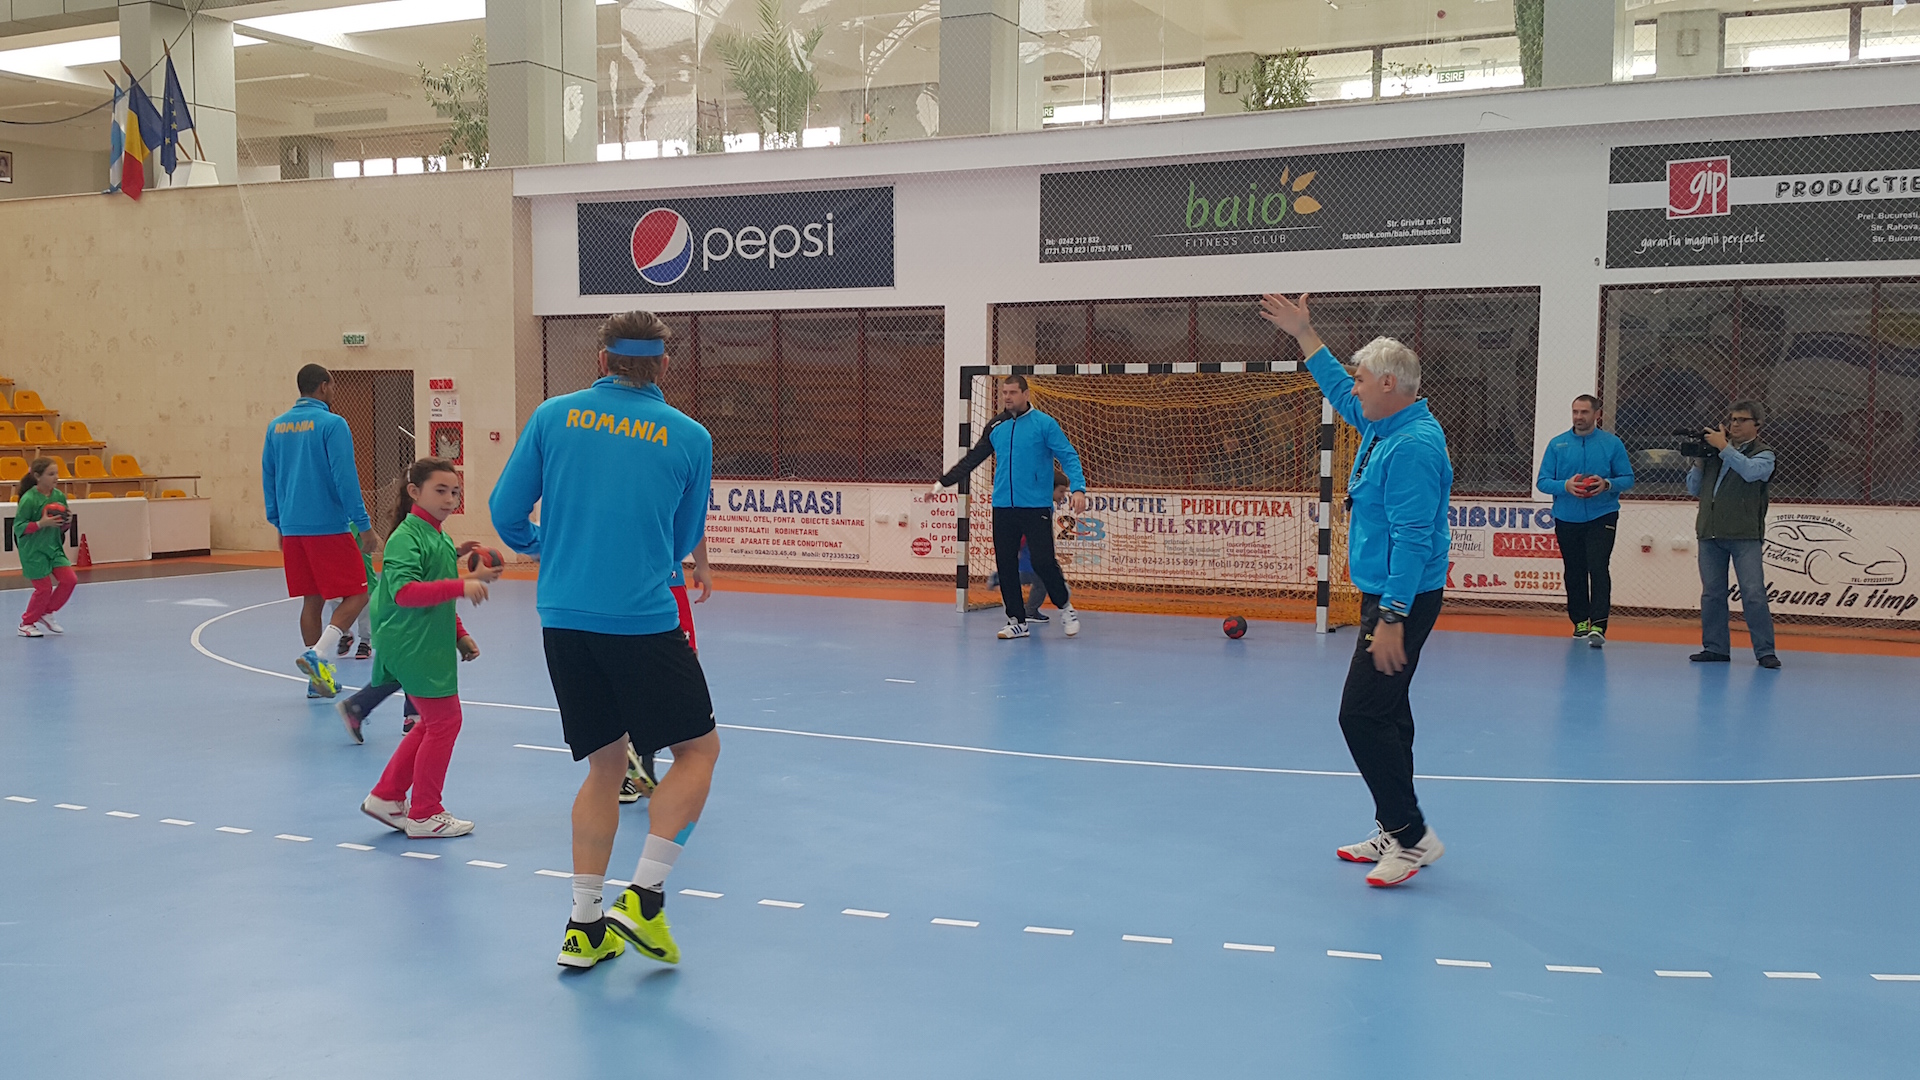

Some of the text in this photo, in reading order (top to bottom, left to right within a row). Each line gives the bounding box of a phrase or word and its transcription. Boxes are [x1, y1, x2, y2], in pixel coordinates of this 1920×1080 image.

[1669, 162, 1727, 214] gip
[1185, 180, 1287, 231] baio
[1387, 220, 1399, 228] Str.
[1438, 217, 1452, 225] 160
[1058, 237, 1074, 245] 0242
[1075, 236, 1087, 244] 312
[1185, 234, 1287, 248] FITNESS CLUB
[1342, 227, 1452, 240] facebook.com/baio.fitnessclub
[1634, 226, 1766, 254] garantia imaginii perfecte
[702, 212, 834, 271] pepsi
[1045, 247, 1060, 255] 0731
[1074, 246, 1086, 254] 823
[1090, 245, 1106, 253] 0753
[1107, 244, 1119, 252] 706
[274, 420, 314, 434] ROMANIA
[566, 409, 668, 447] ROMANIA
[728, 488, 842, 515] CALARASI
[1181, 498, 1294, 518] PUBLICITARA
[1447, 505, 1556, 529] RIBUITO
[733, 526, 770, 534] INSTALATII
[775, 528, 819, 536] ROBINETARIE
[1133, 517, 1267, 537] FULL SERVICE
[1451, 529, 1473, 541] Perla
[797, 540, 843, 548] CONDITIONAT
[940, 546, 956, 554] Tel.
[1463, 573, 1507, 588] S.R.L.
[1514, 571, 1539, 579] 0242
[1543, 572, 1560, 580] 311
[1514, 580, 1561, 590] 0753 097
[1836, 585, 1859, 608] la
[1864, 588, 1919, 616] timp
